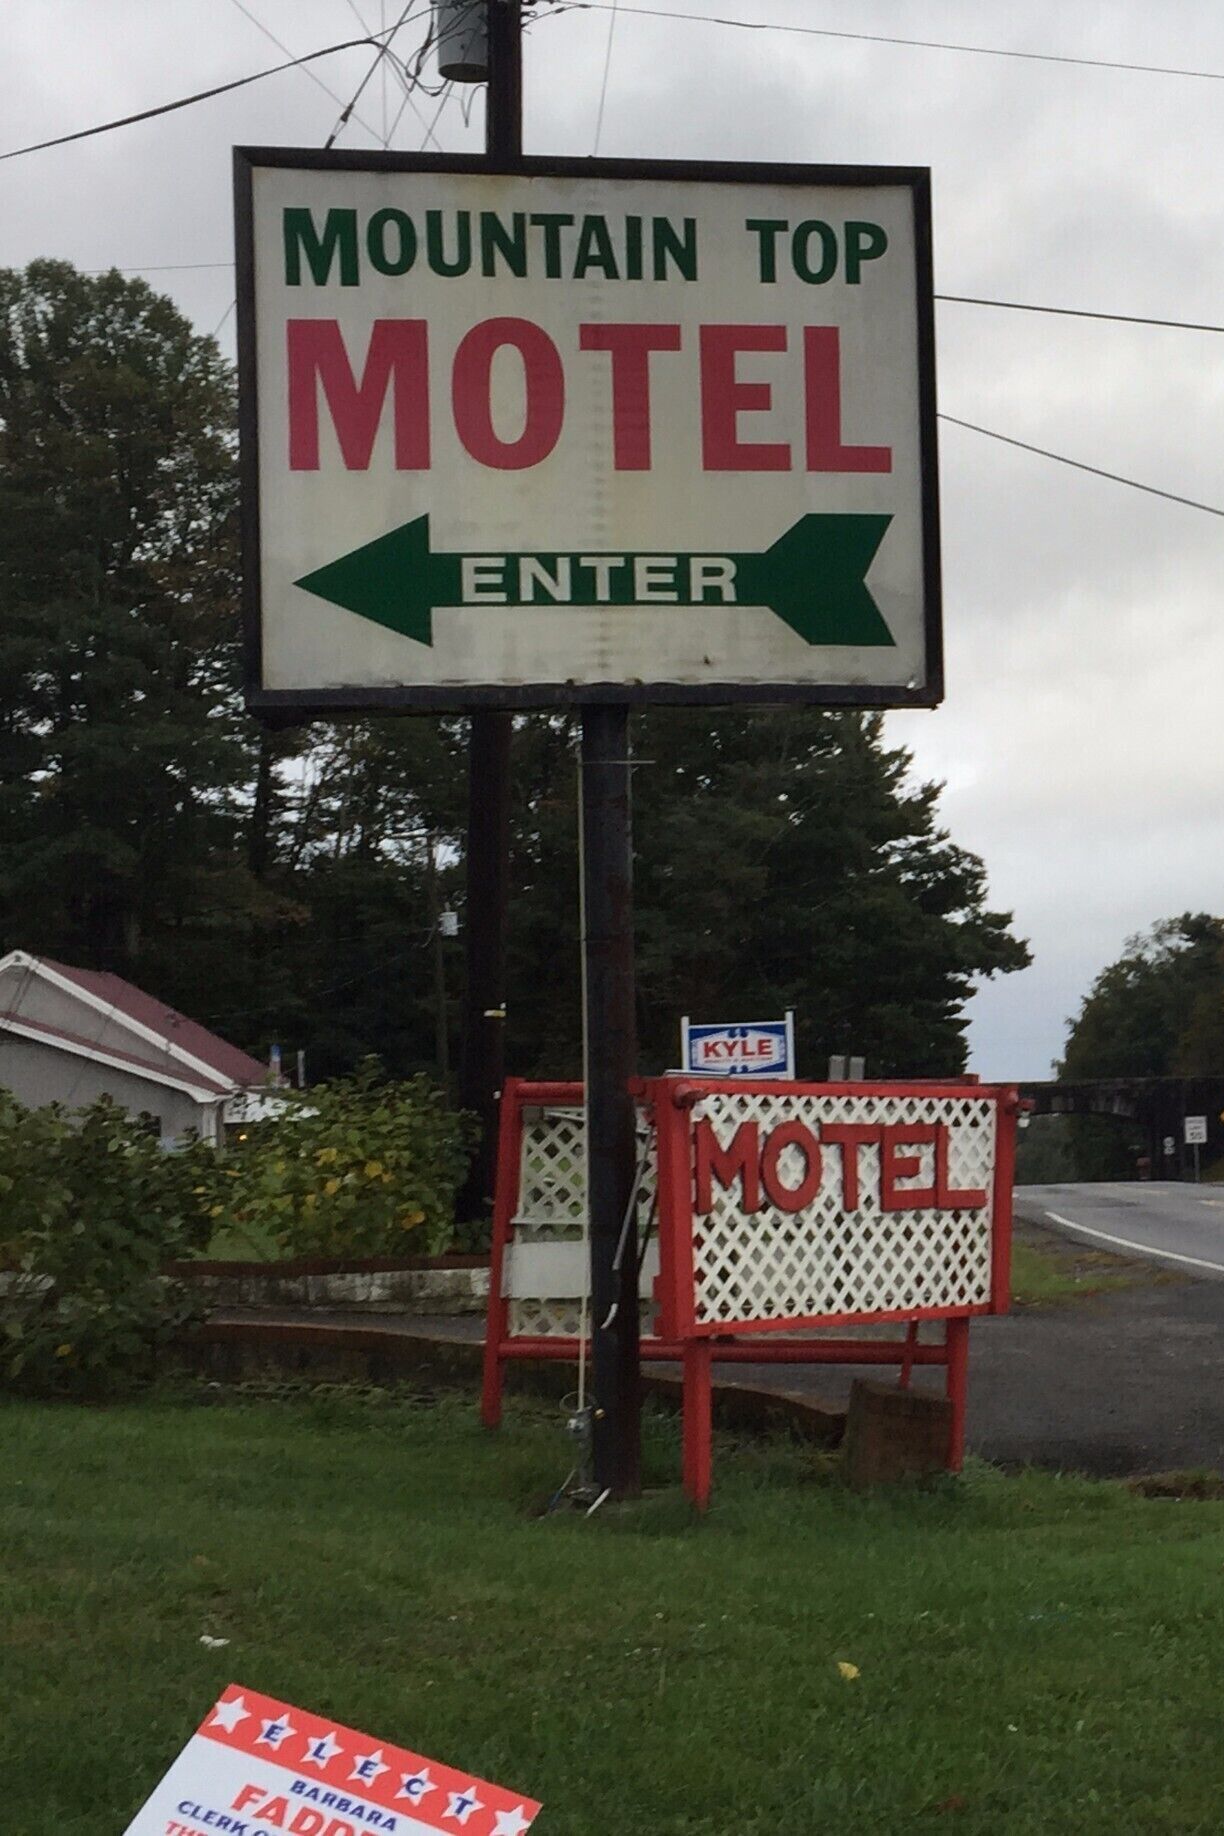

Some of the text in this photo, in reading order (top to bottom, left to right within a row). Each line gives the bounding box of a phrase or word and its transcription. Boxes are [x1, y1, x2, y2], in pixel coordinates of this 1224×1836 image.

[282, 207, 889, 287] MOUNTAIN TOP
[286, 316, 893, 473] MOTEL
[459, 556, 738, 603] ENTER
[703, 1038, 773, 1058] KYLE
[693, 1120, 988, 1214] MOTEL
[262, 1723, 474, 1816] ELECT
[178, 1800, 250, 1836] CLERK
[231, 1784, 382, 1836] FADD
[289, 1780, 398, 1832] BARBARA
